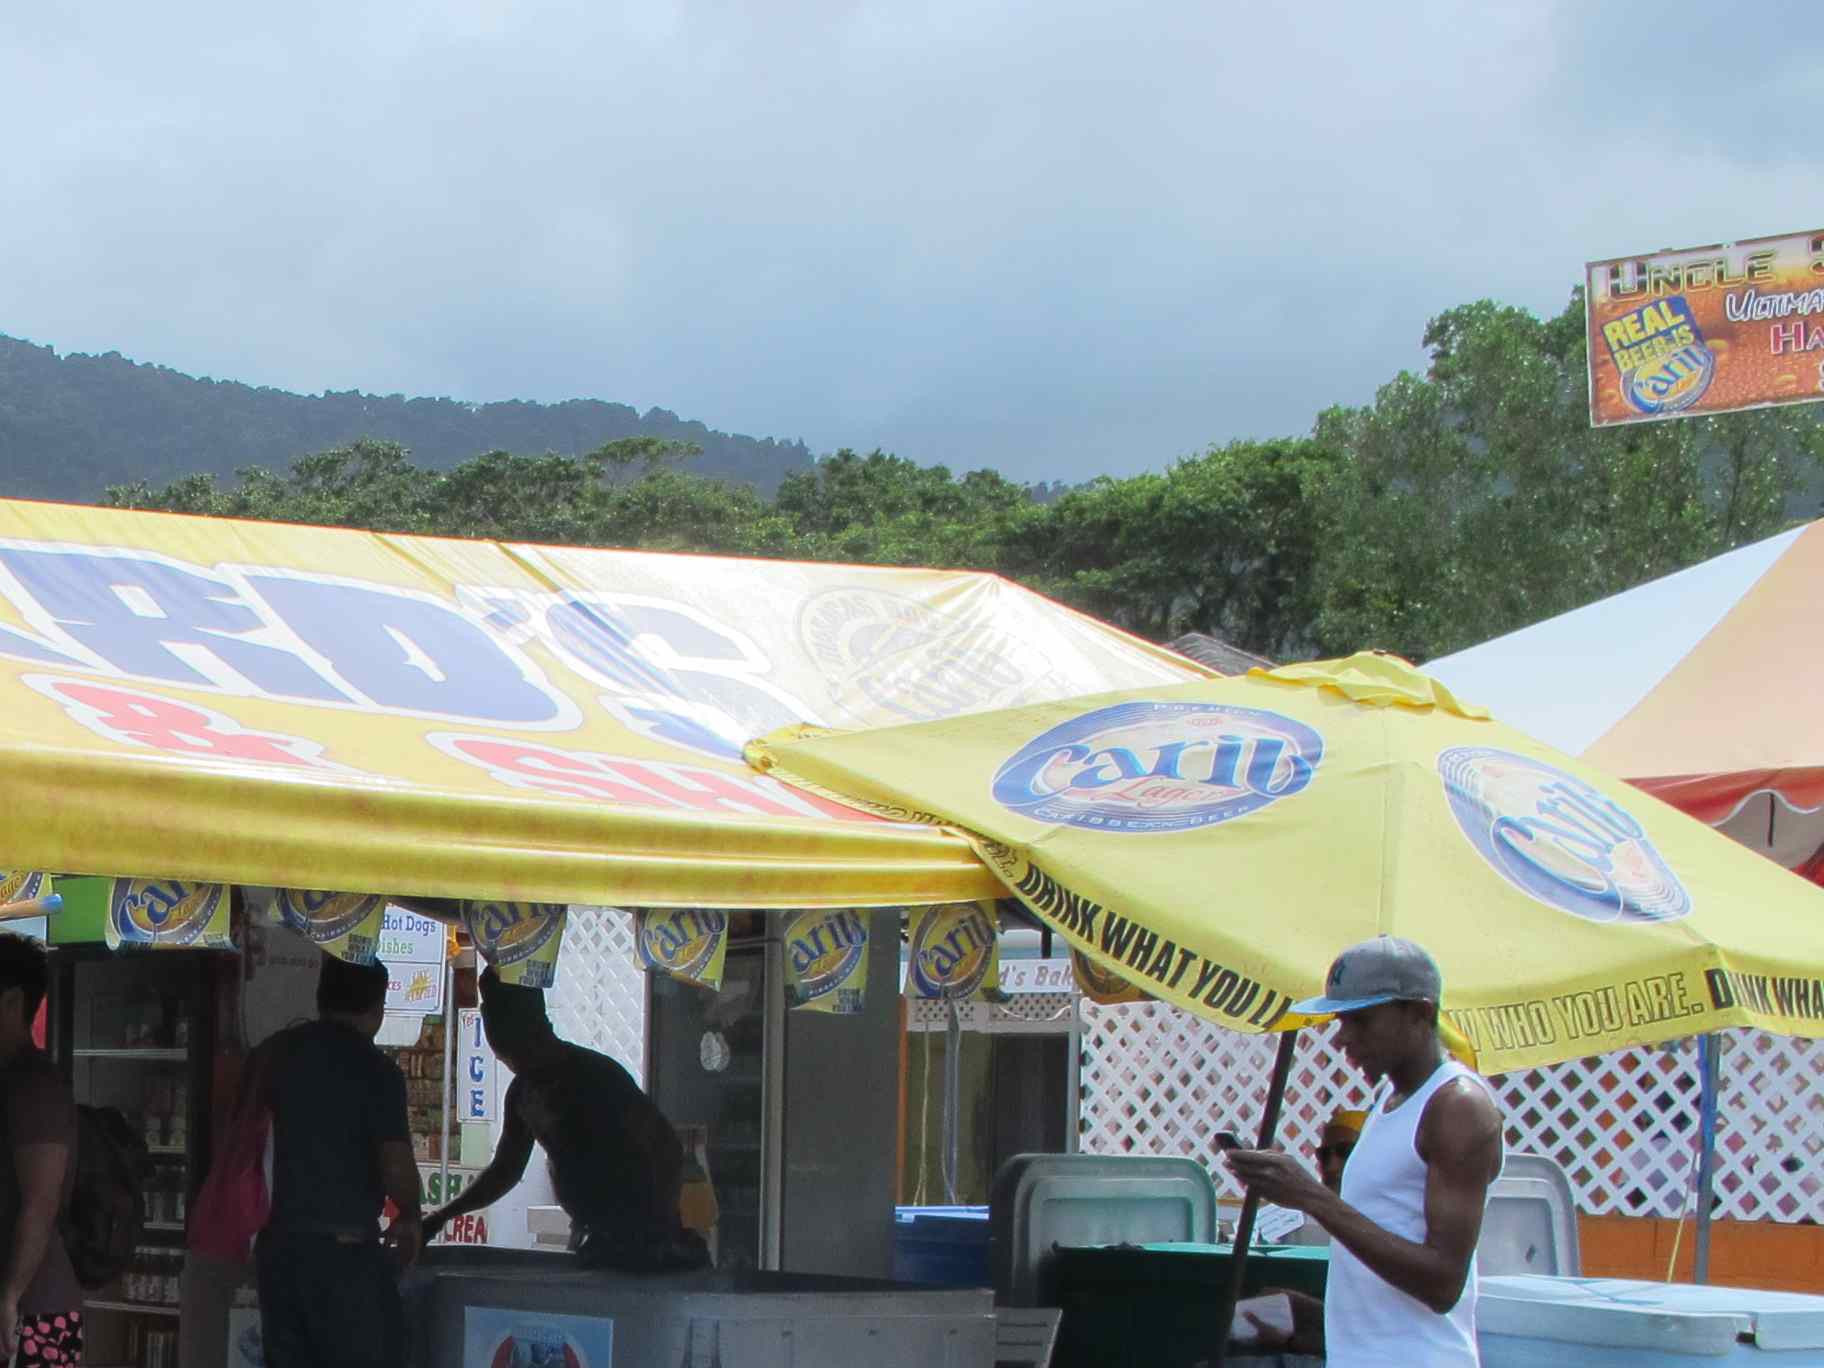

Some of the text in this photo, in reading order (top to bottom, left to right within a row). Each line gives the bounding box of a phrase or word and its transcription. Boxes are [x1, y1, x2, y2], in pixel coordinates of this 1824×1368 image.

[1603, 300, 1686, 352] REAL
[1727, 288, 1824, 322] ULTIMA
[22, 674, 341, 775] &
[992, 733, 1313, 807] Carib
[406, 915, 437, 937] Dogs
[791, 911, 867, 975] arib
[1016, 862, 1101, 943] DRINK
[1101, 911, 1197, 988] WHAT
[1189, 959, 1260, 1018] YOU
[1035, 965, 1074, 987] Bak
[1479, 998, 1556, 1051] WHO
[1554, 985, 1624, 1040] YOU
[1623, 971, 1706, 1029] ARE.
[1772, 976, 1824, 1020] WHA
